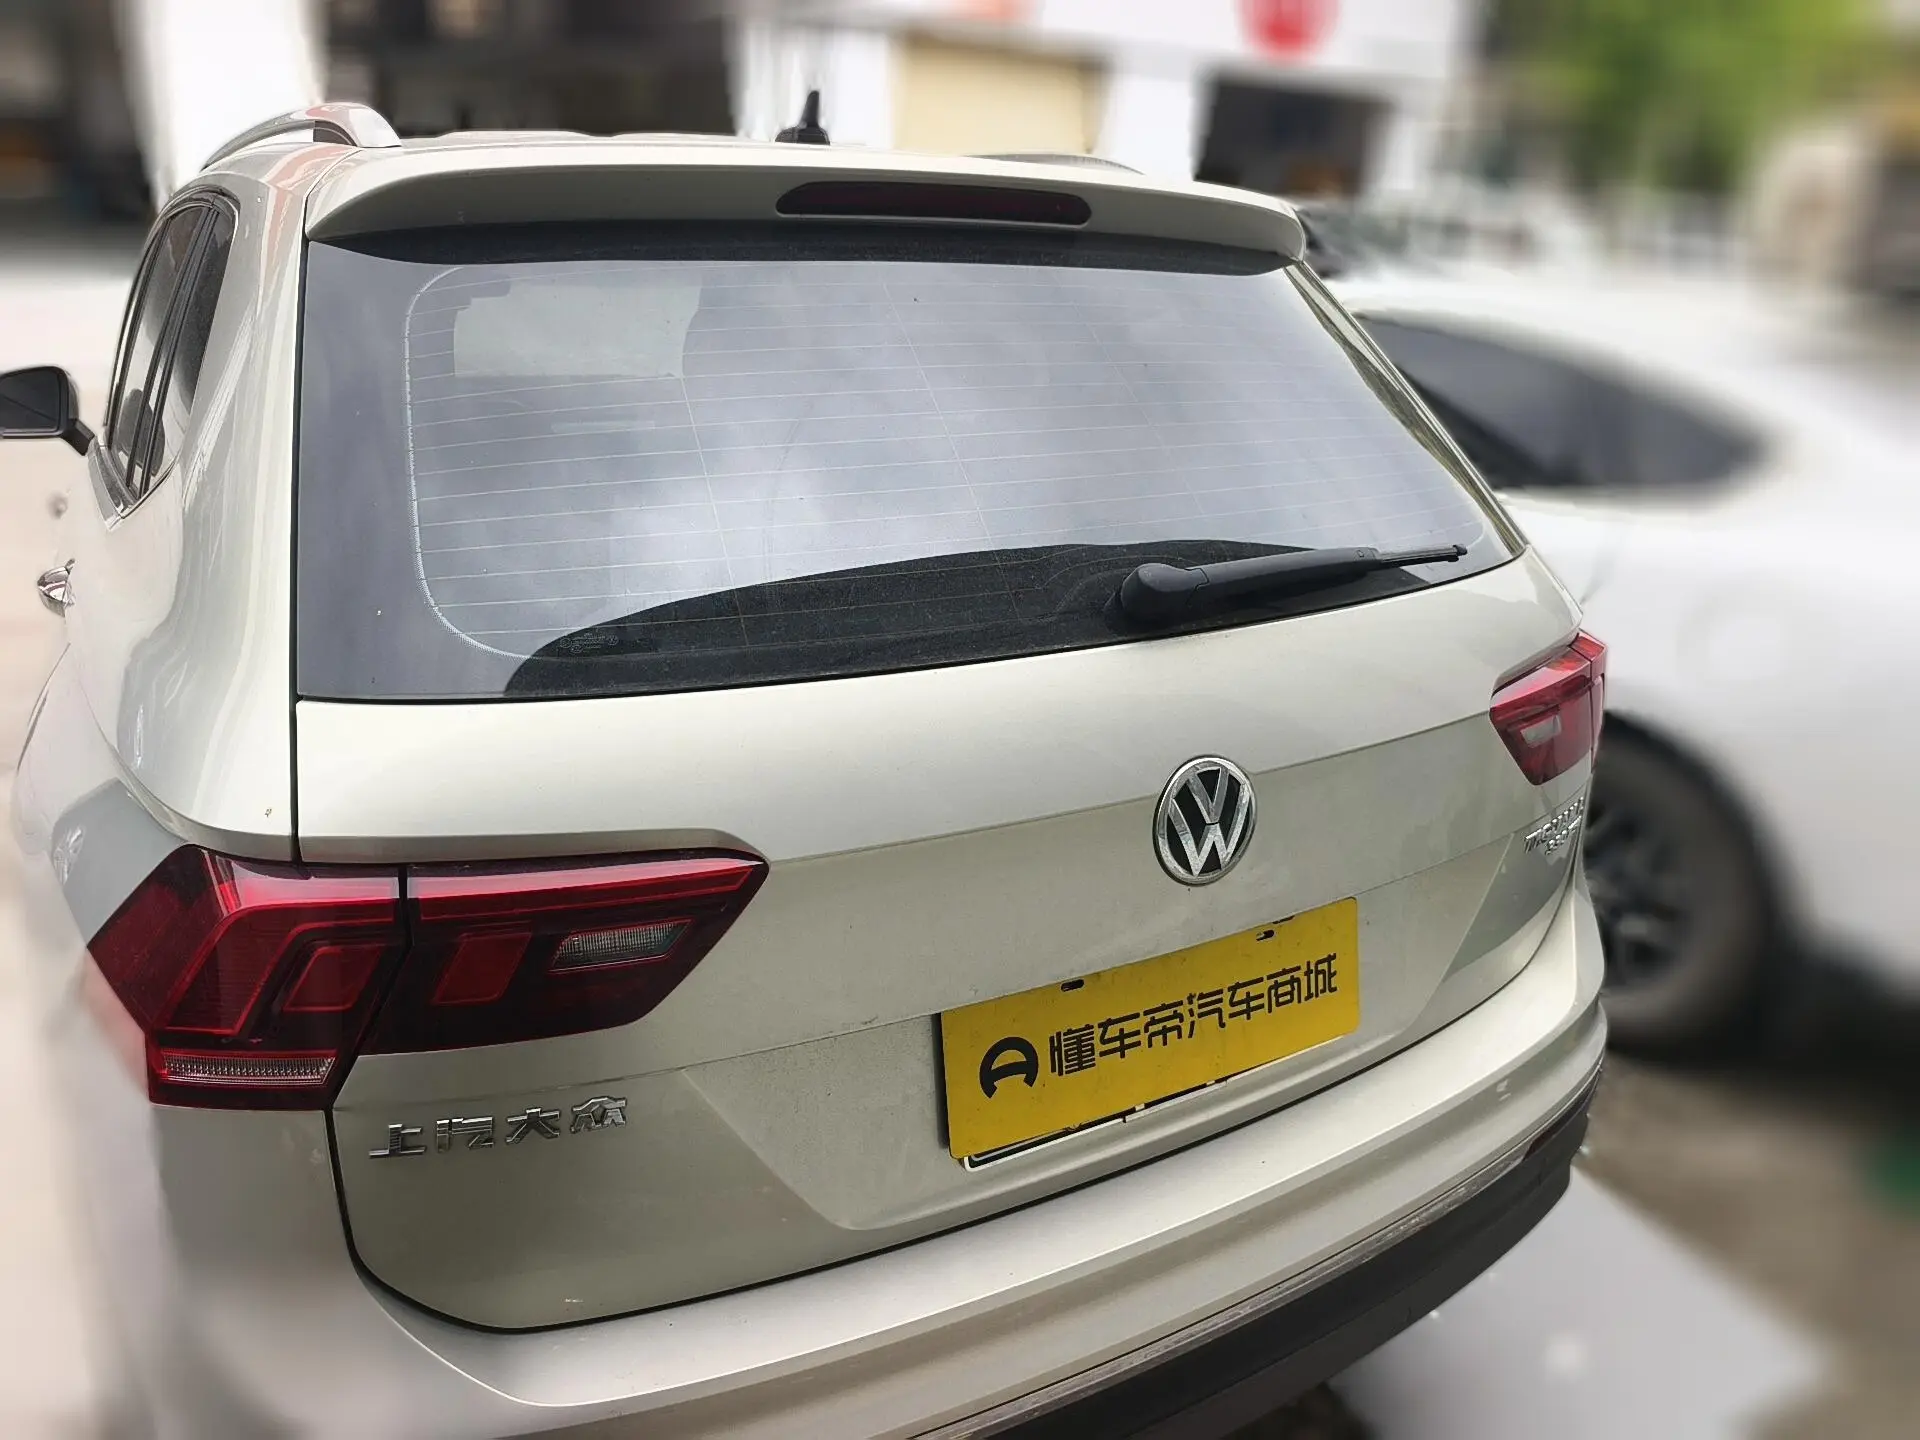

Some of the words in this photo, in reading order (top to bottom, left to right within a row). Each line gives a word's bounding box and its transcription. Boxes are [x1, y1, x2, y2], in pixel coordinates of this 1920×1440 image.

[1164, 763, 1251, 879] VW
[1048, 951, 1338, 1077] 懂车帝汽车商城
[368, 1095, 627, 1158] 上汽大众
